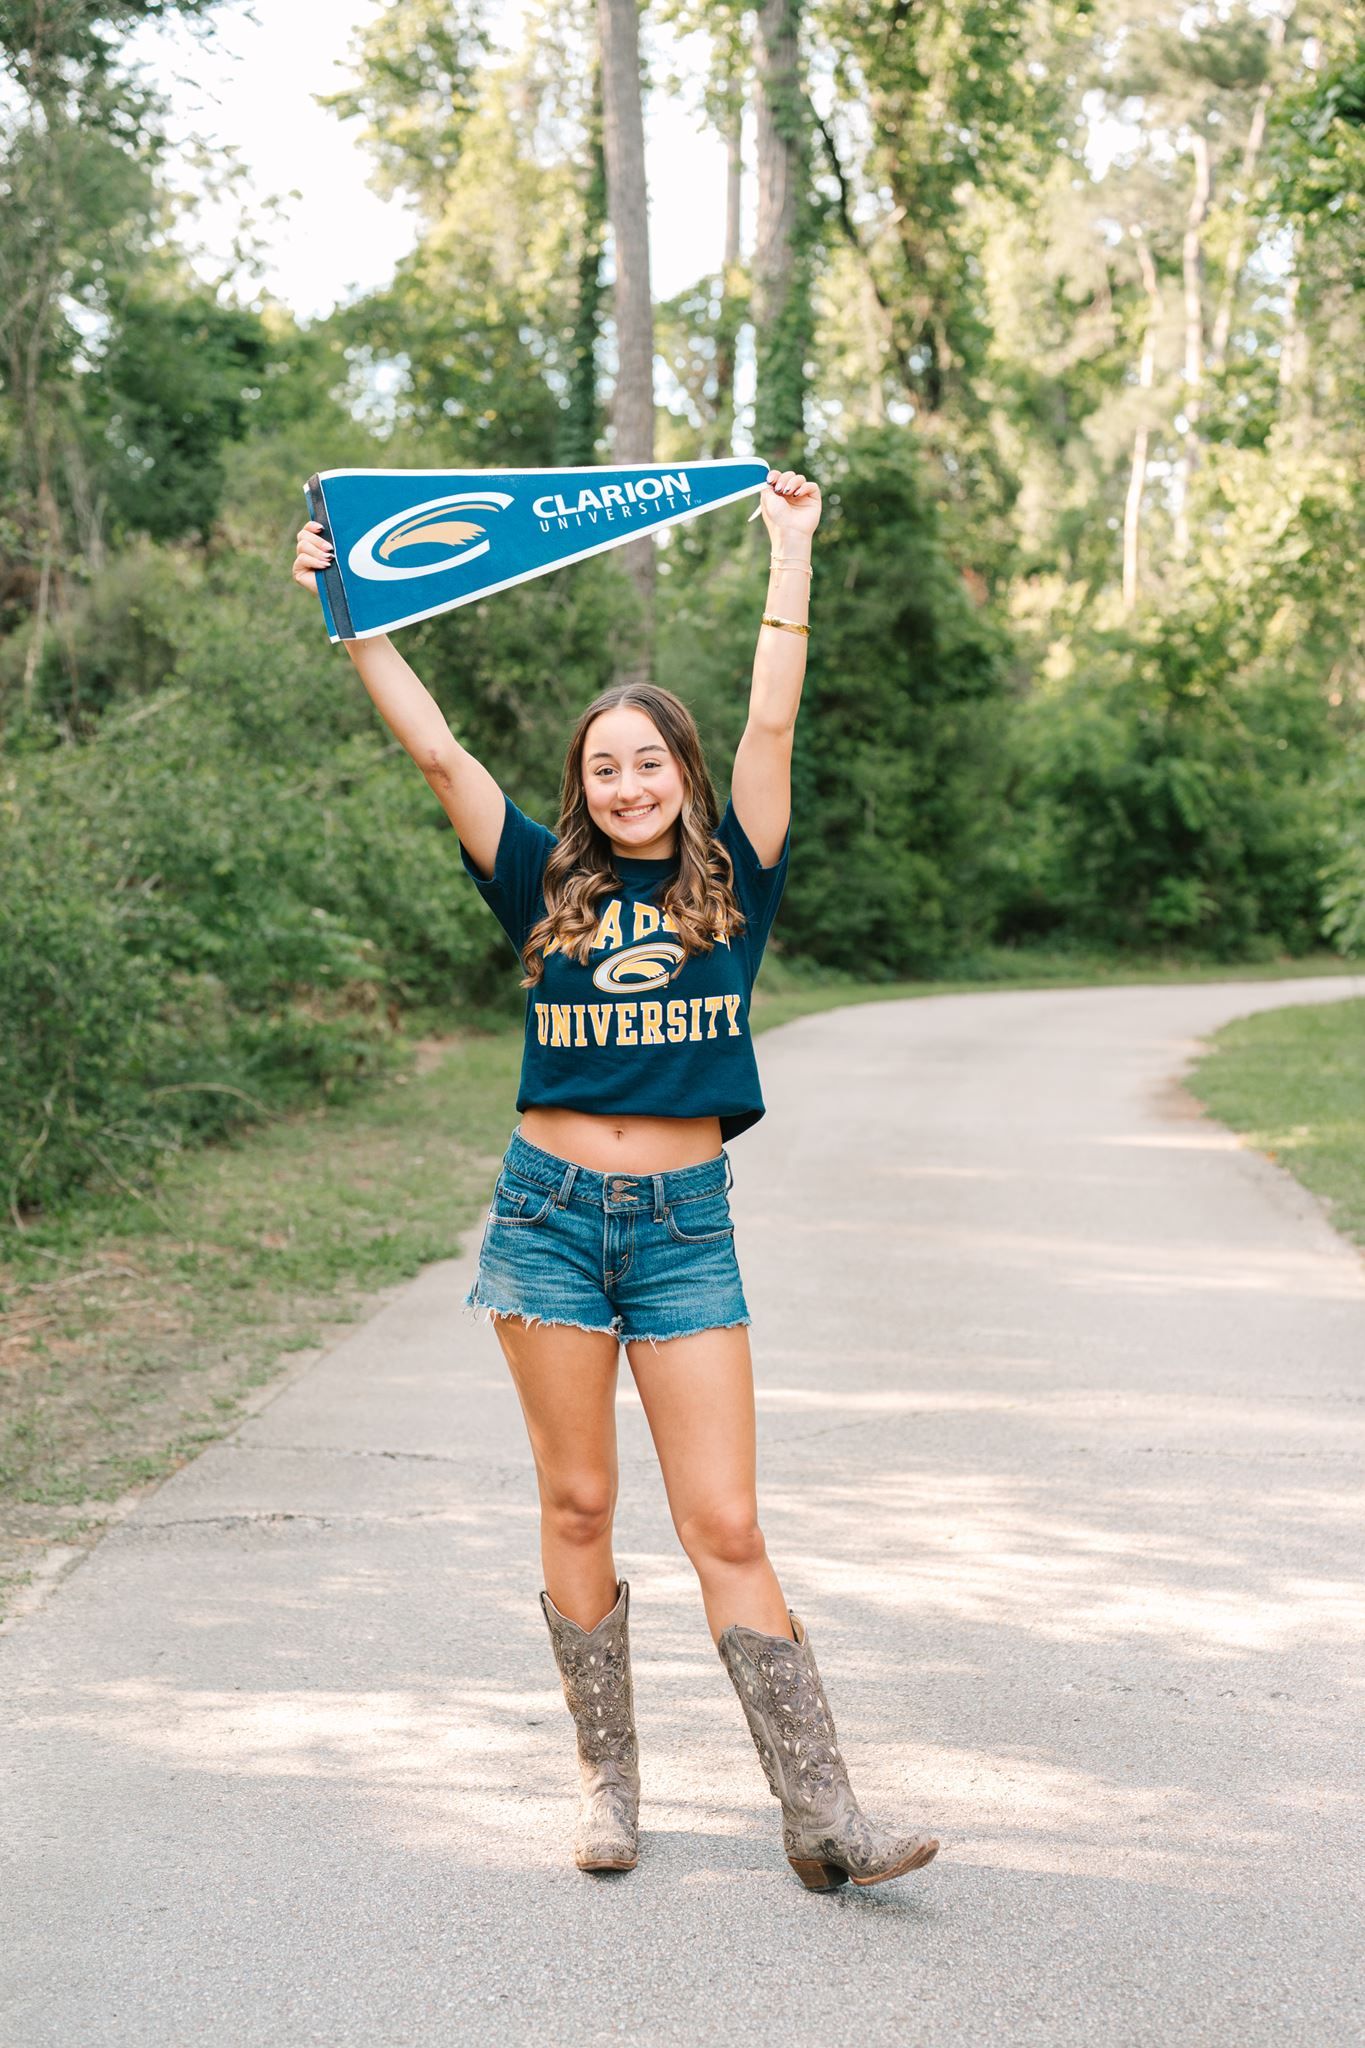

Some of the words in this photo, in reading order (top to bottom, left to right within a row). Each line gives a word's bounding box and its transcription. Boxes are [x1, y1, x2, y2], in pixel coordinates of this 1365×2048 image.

[532, 472, 692, 519] CLARION
[539, 493, 691, 533] UNIVERSITY
[535, 994, 741, 1048] UNIVERSITY
